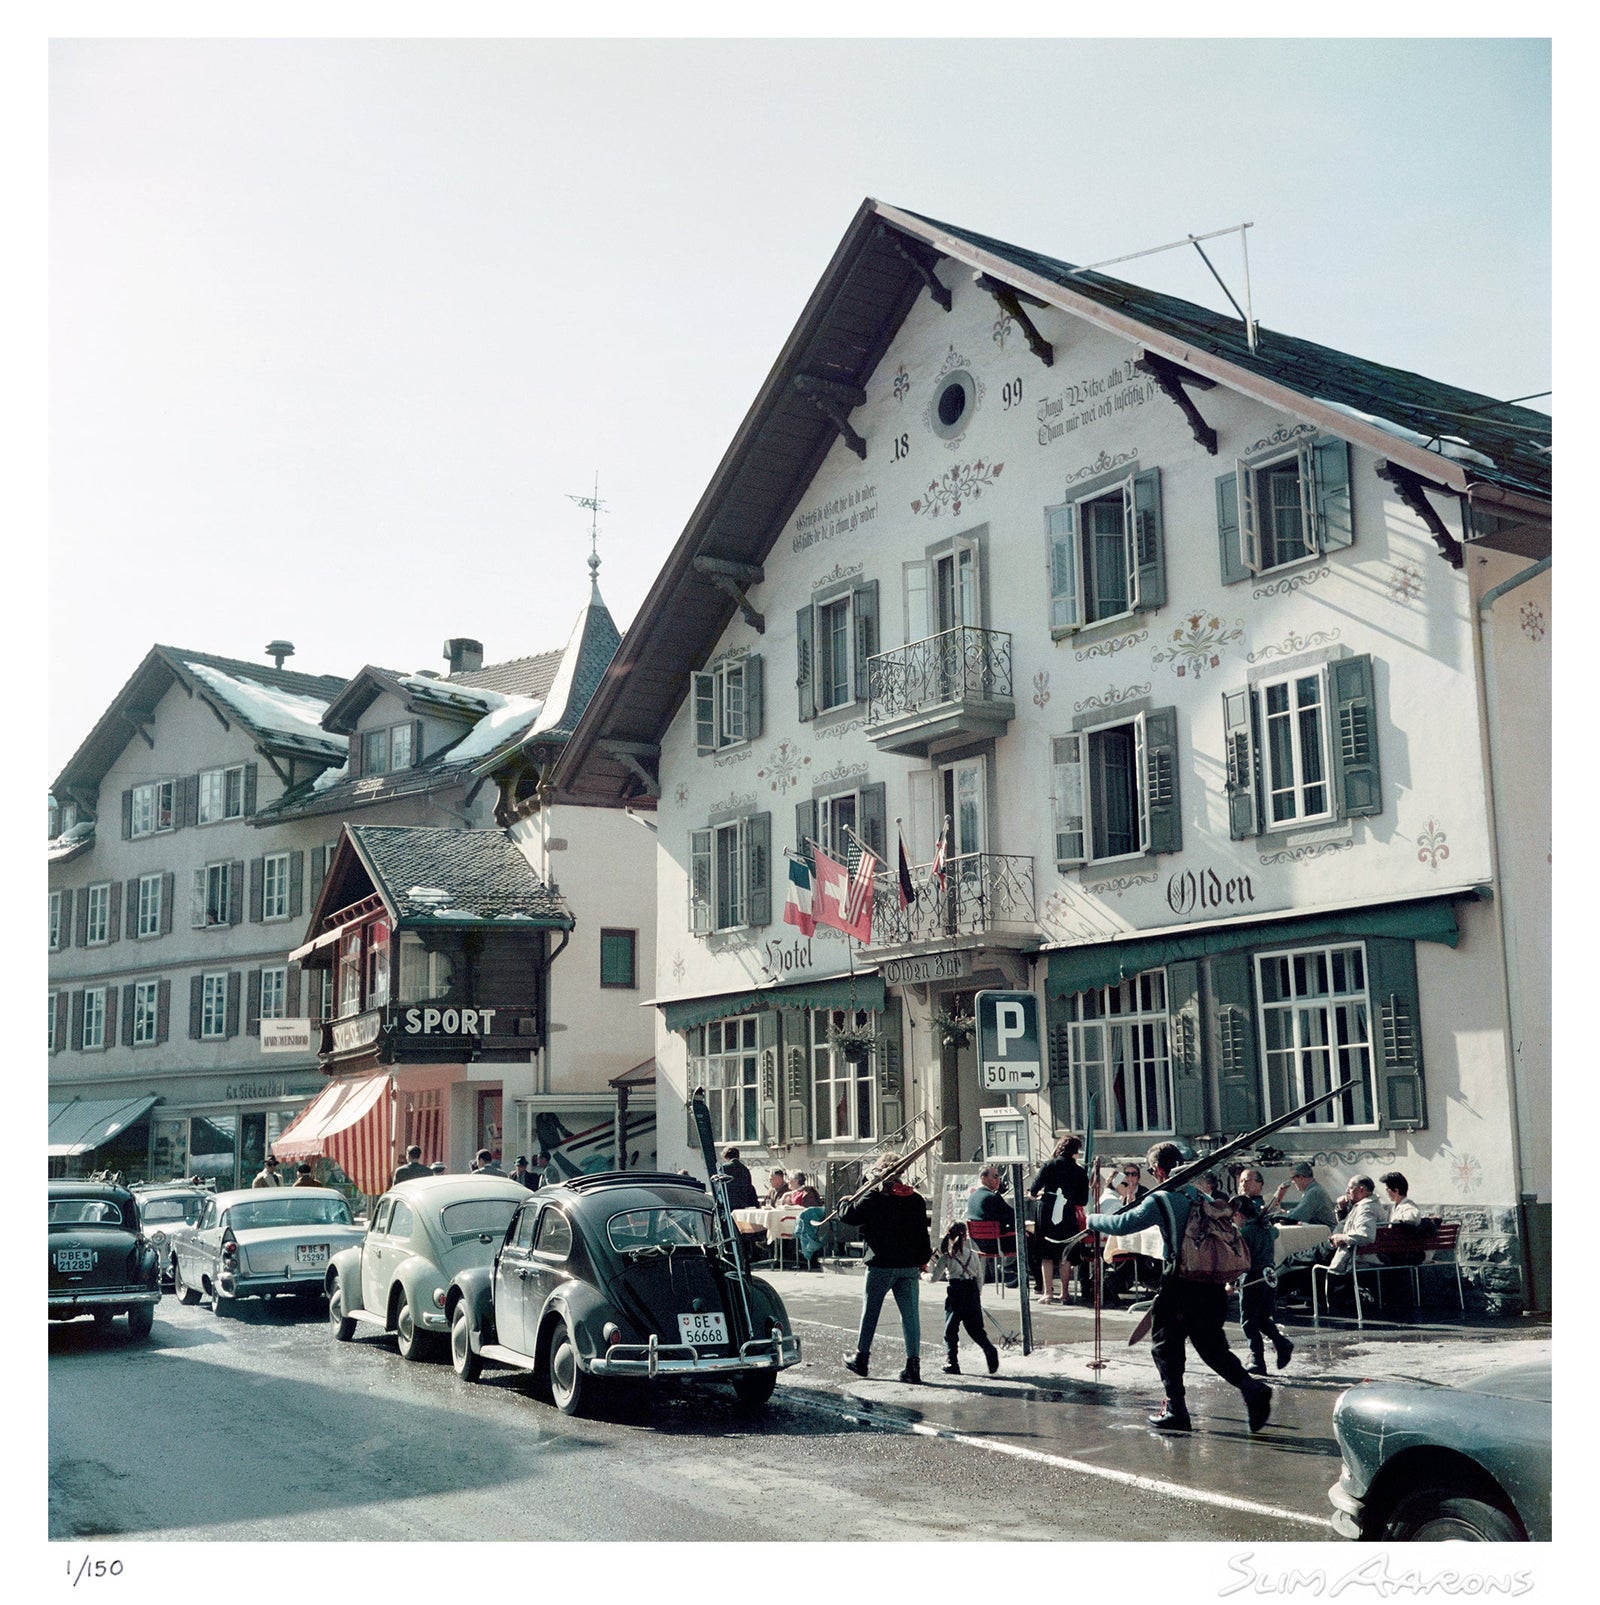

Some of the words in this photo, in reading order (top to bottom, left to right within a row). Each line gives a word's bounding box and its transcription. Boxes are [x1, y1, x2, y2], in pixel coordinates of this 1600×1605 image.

[1002, 377, 1022, 411] 99
[890, 433, 909, 463] 18
[1166, 866, 1255, 916] Olden
[761, 936, 813, 977] Hotel
[887, 959, 930, 983] Olden
[934, 955, 961, 977] Bar
[405, 1008, 496, 1034] SPORT
[996, 1001, 1025, 1056] P
[988, 1066, 1006, 1082] 50
[1009, 1070, 1019, 1082] m
[60, 1260, 91, 1270] 21285
[68, 1251, 81, 1260] BE
[694, 1315, 710, 1328] GE
[686, 1329, 723, 1343] 56668
[67, 1554, 123, 1587] 1/150
